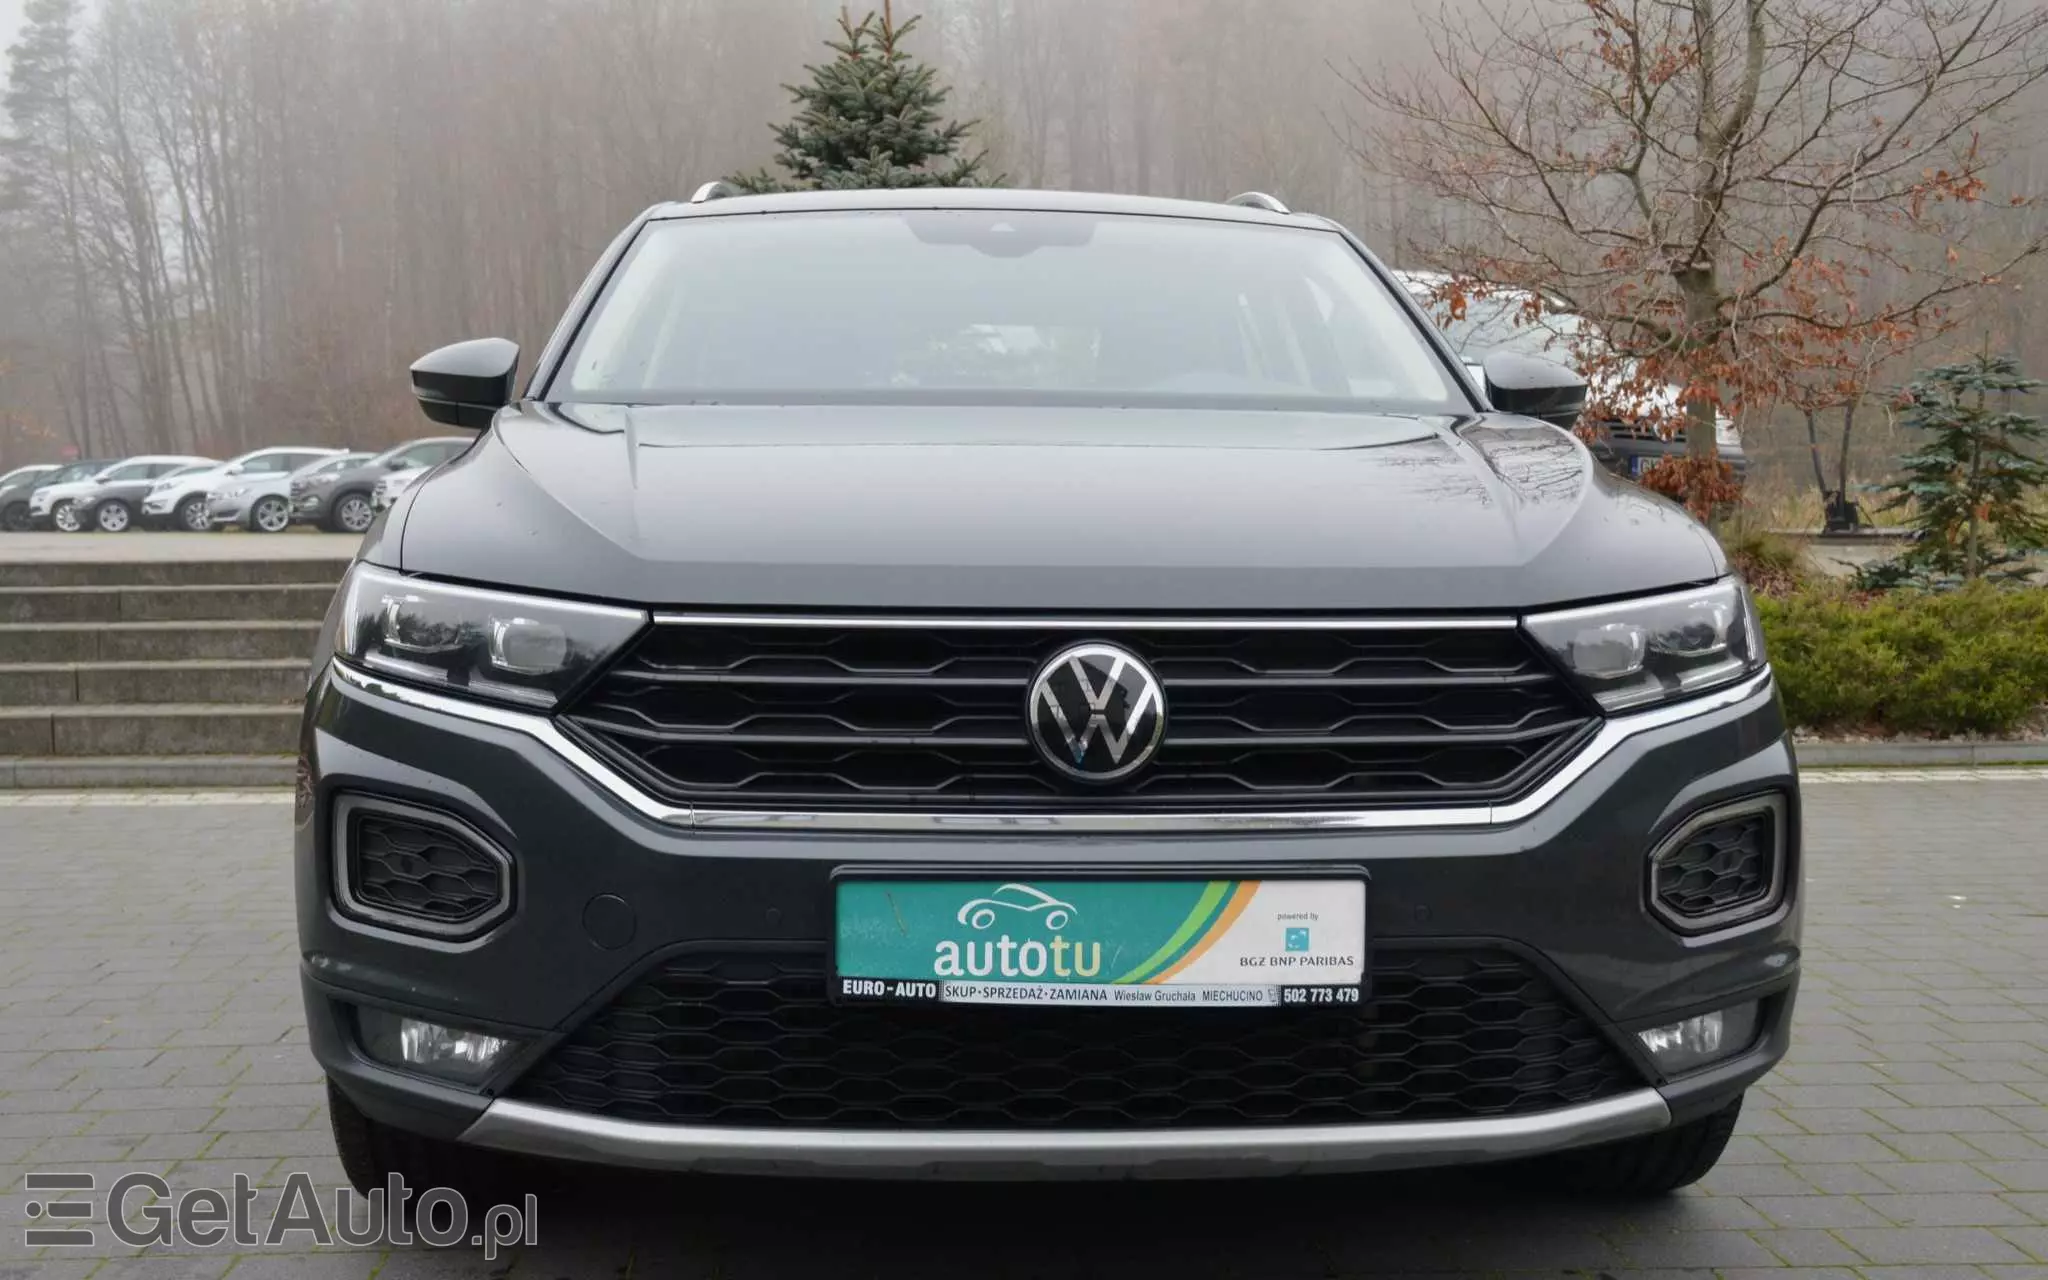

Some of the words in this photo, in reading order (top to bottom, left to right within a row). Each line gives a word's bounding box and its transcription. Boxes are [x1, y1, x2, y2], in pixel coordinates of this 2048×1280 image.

[1277, 912, 1308, 920] powered
[1310, 911, 1319, 921] by
[934, 934, 1101, 977] autotu
[1270, 957, 1296, 966] BNP
[1300, 956, 1354, 966] PARIBAS
[945, 985, 976, 998] SKUP
[1050, 989, 1107, 1000] ZAMIANA
[1202, 990, 1263, 1001] MIECHUCINO
[1284, 988, 1307, 1002] 502
[1310, 988, 1333, 1002] 773
[1336, 988, 1359, 1002] 479
